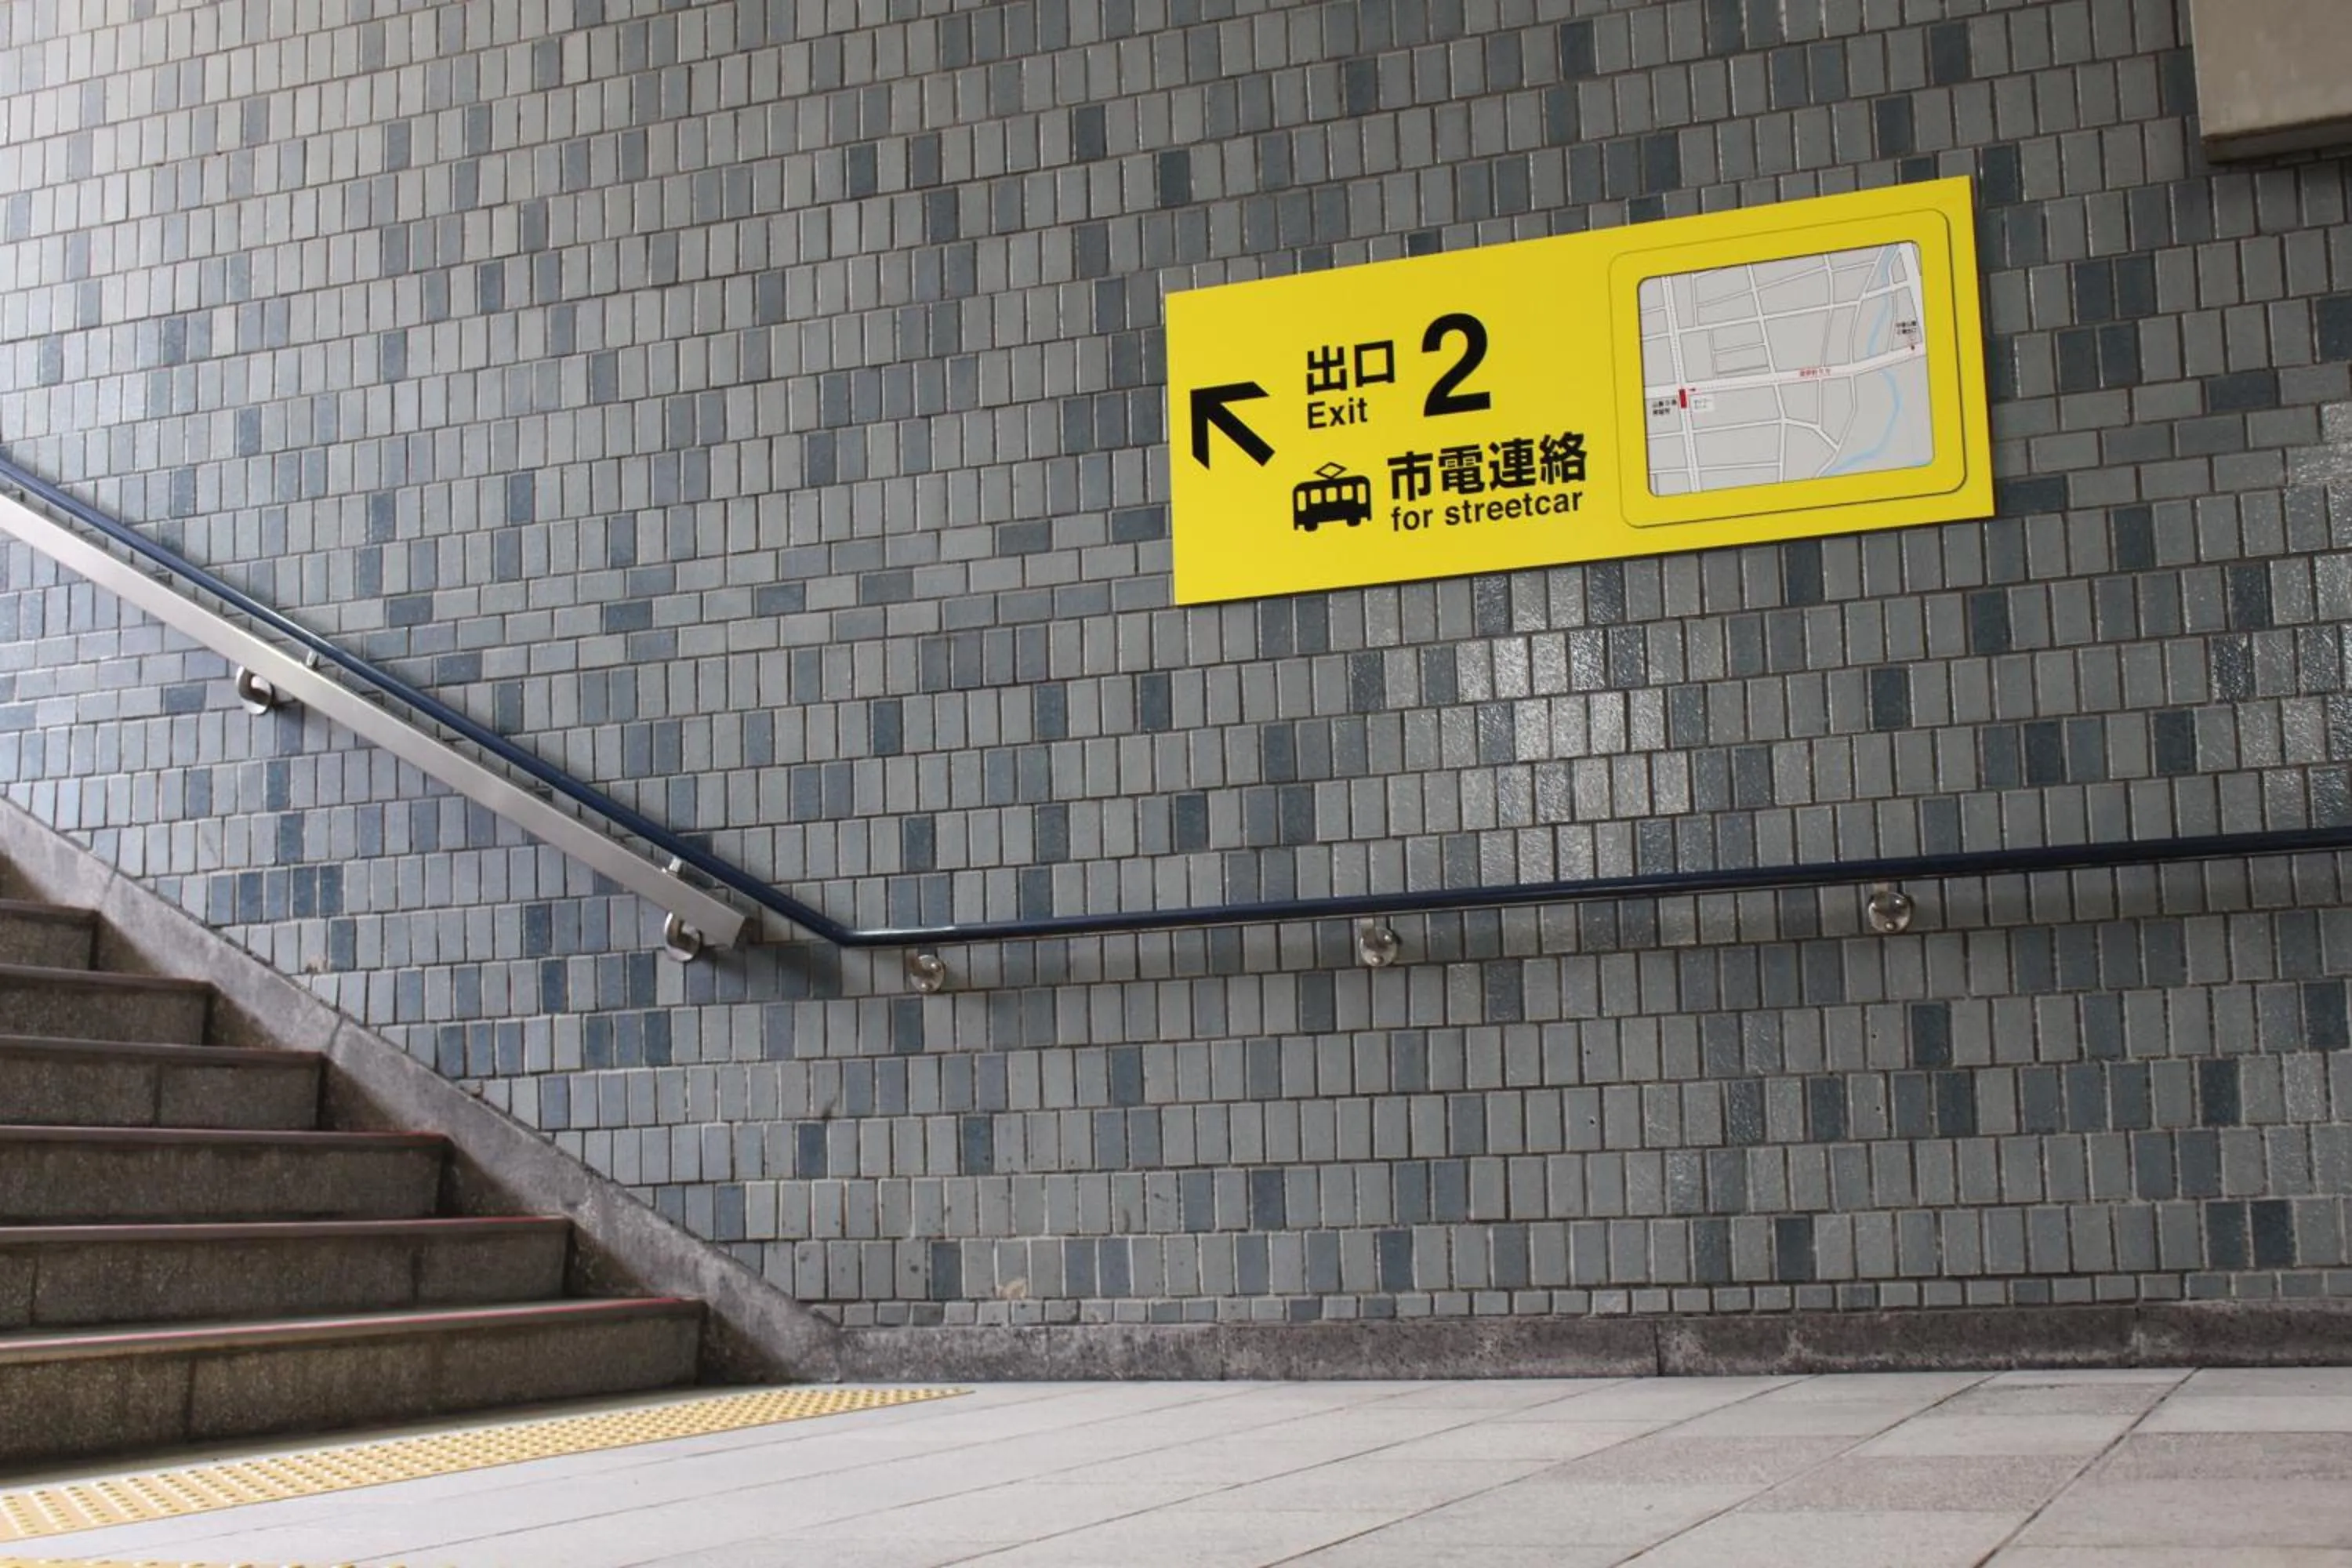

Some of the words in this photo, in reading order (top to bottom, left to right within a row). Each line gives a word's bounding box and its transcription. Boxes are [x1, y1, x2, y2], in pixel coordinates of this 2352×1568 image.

[1306, 339, 1396, 395] 出口
[1421, 313, 1491, 417] 2
[1307, 397, 1368, 429] Exit
[1387, 431, 1588, 502] 市電連絡
[1391, 506, 1433, 532] for
[1445, 492, 1583, 526] streetcar
